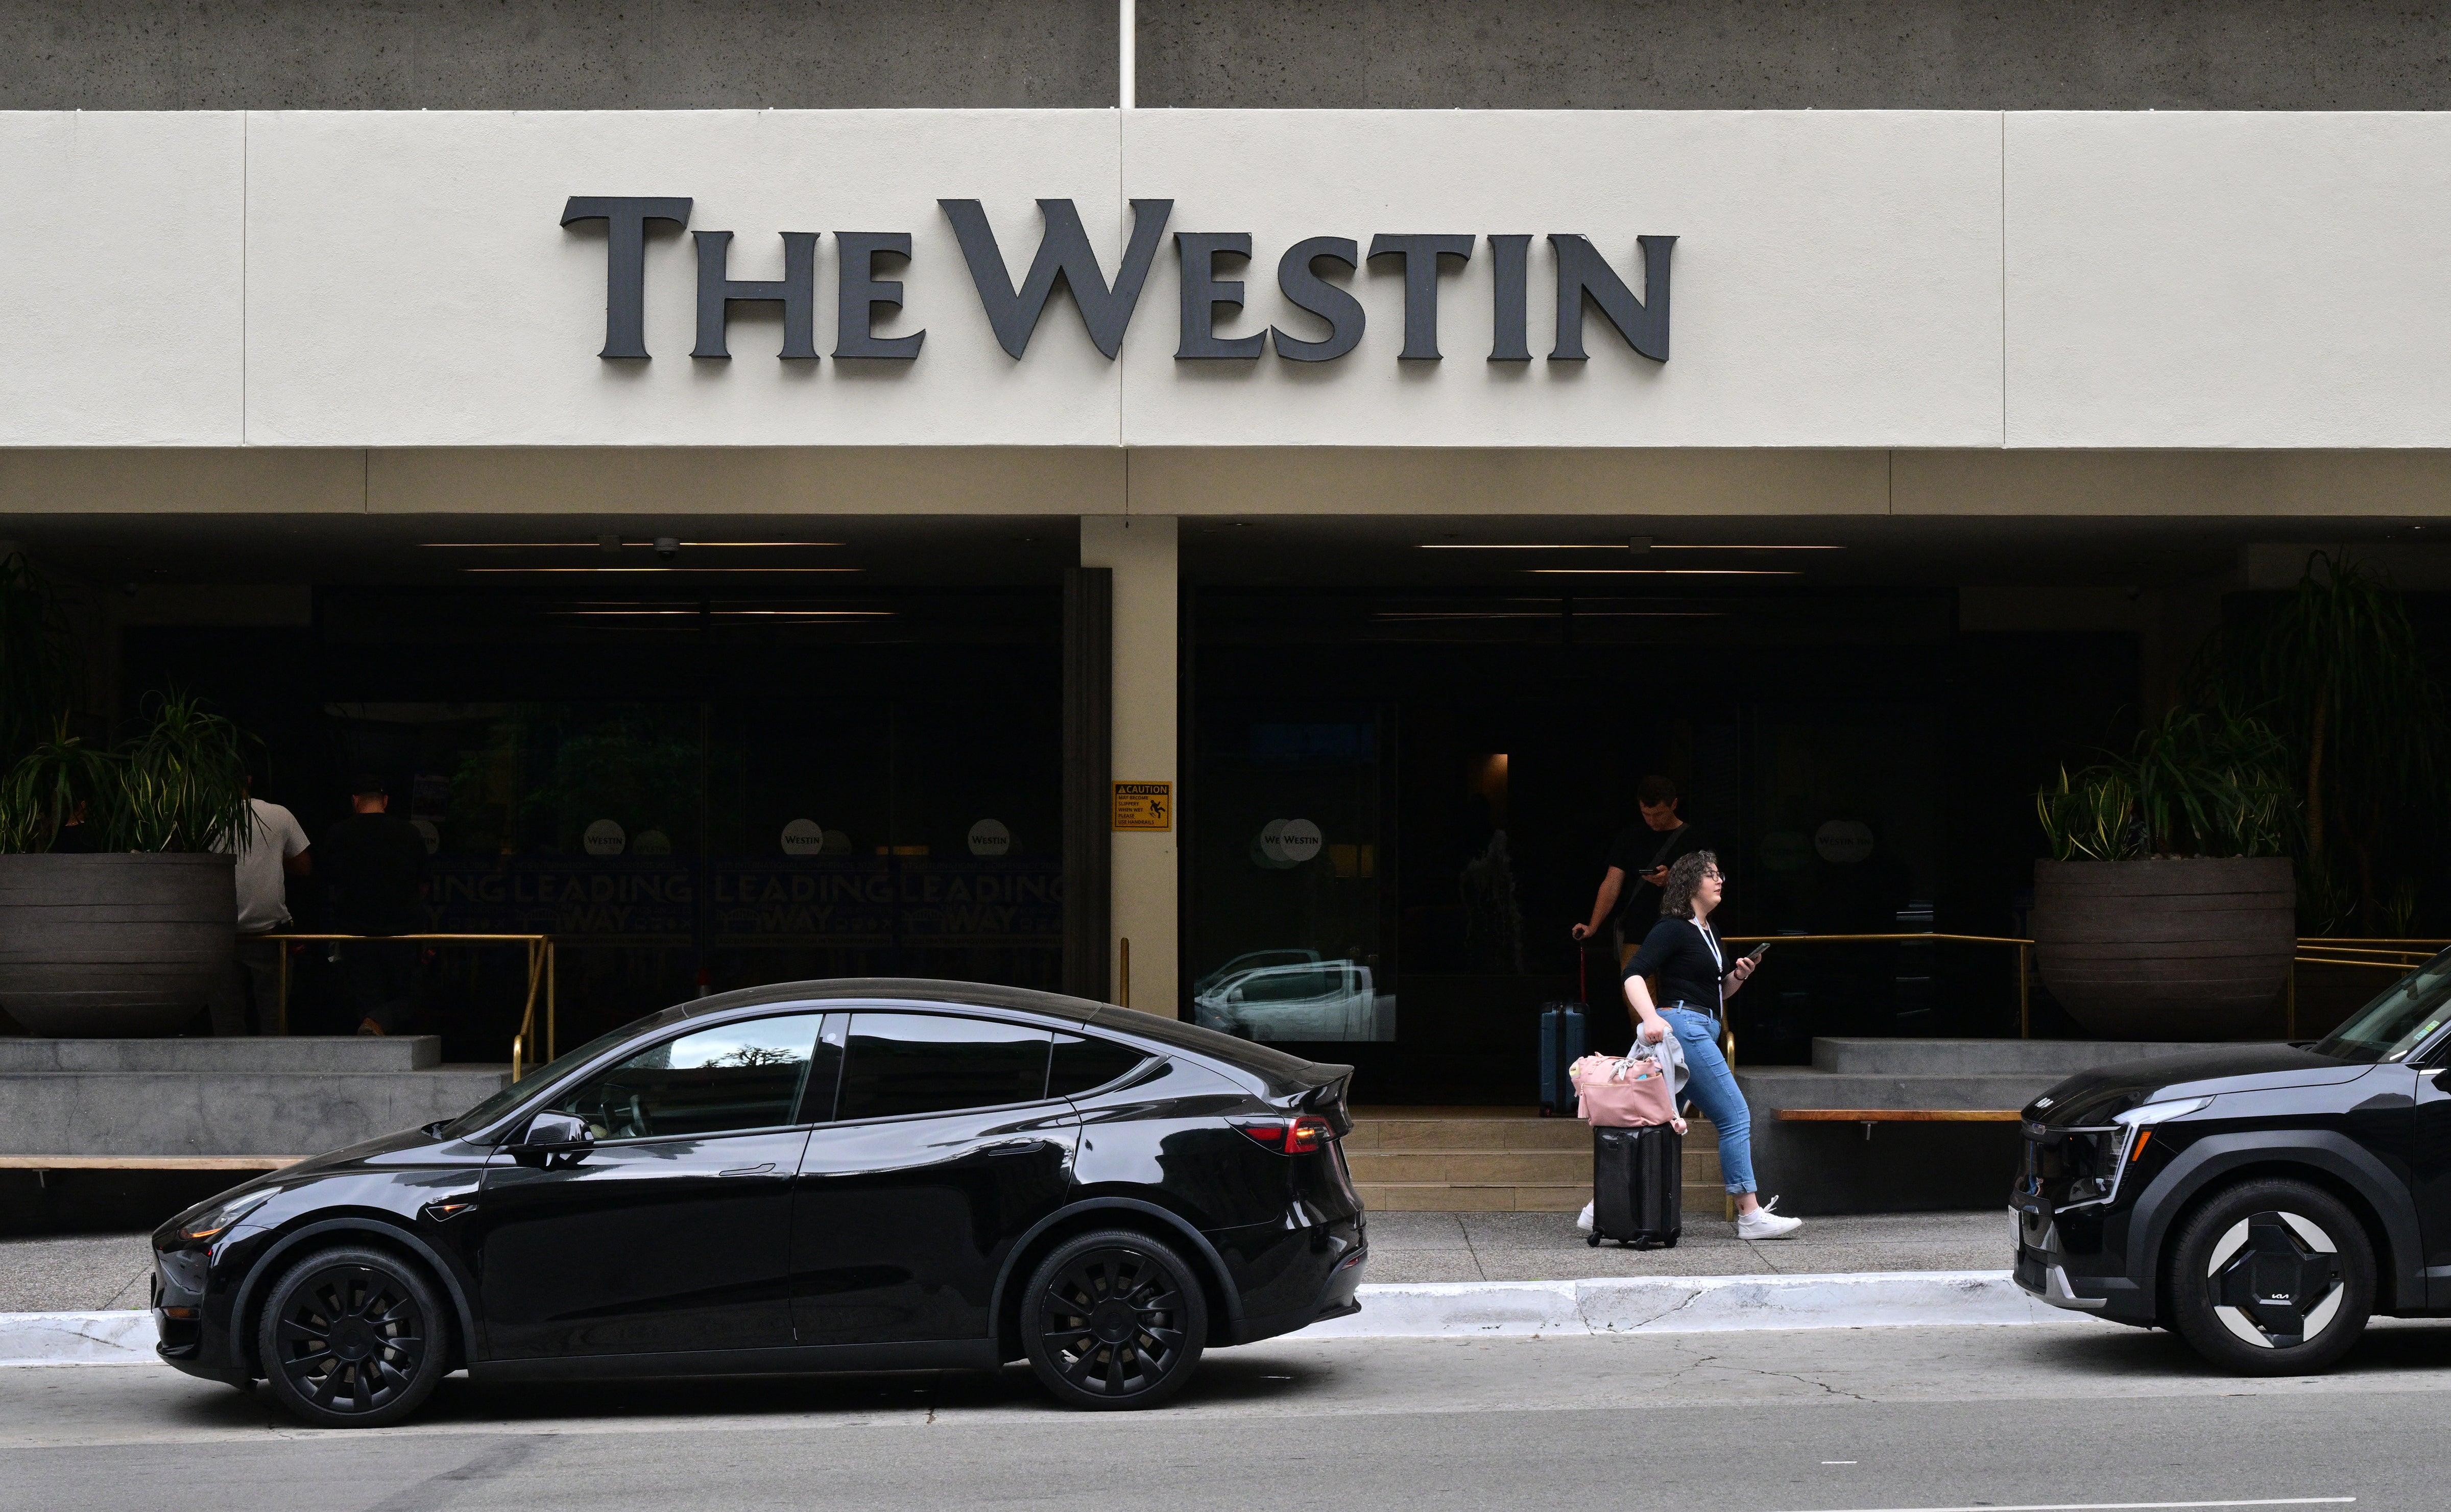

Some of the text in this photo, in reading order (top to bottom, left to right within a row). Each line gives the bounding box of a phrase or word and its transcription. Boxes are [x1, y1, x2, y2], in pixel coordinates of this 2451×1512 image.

[560, 196, 1680, 362] THE WESTIN
[1126, 785, 1167, 794] CAUTION
[587, 835, 623, 845] WESTIN
[785, 835, 820, 844] WESTIN
[972, 835, 1007, 844] WESTIN
[1284, 835, 1319, 844] WESTIN
[1818, 837, 1853, 846] WESTIN
[734, 861, 798, 869] INTERNATIONAL
[800, 861, 855, 869] CONFERENCE
[514, 874, 692, 903] LEADING
[715, 874, 894, 903] LEADING
[563, 904, 635, 932] WAY
[762, 904, 834, 932] WAY
[947, 904, 1019, 932] WAY
